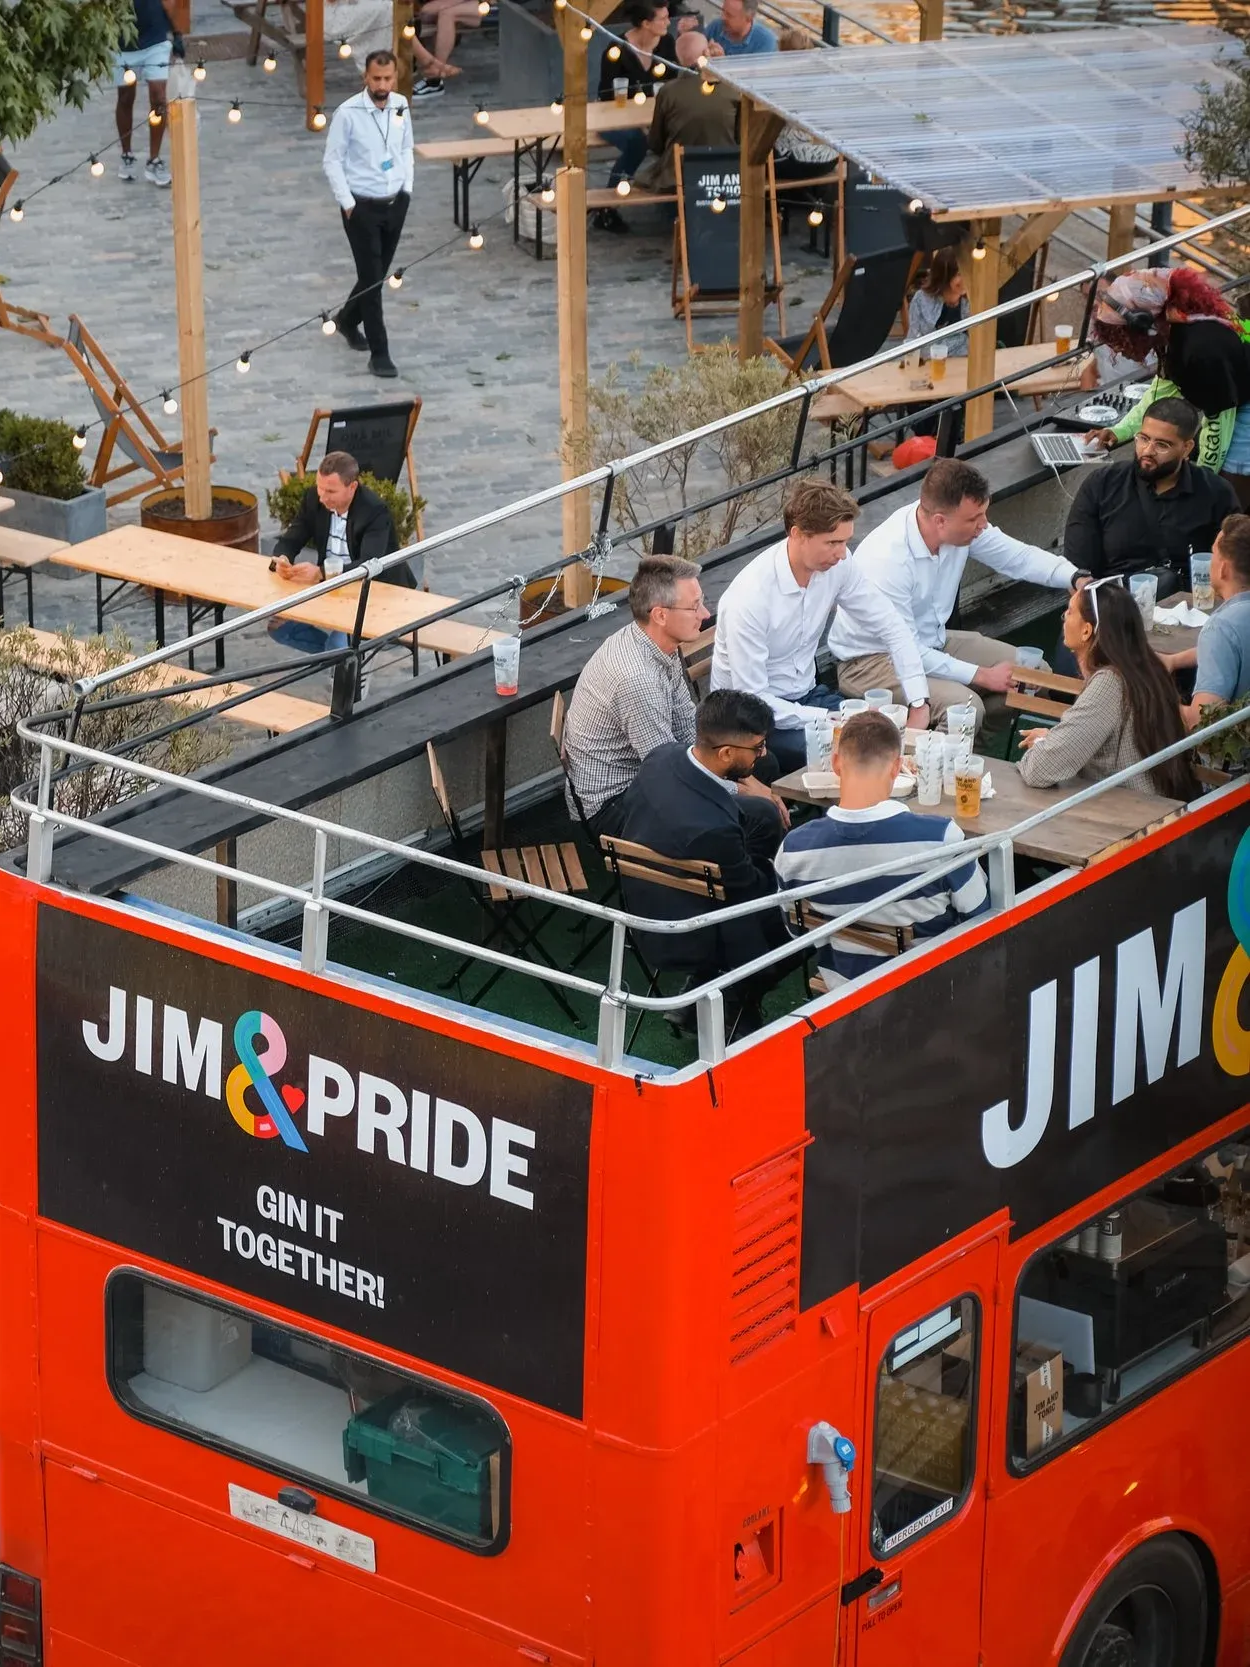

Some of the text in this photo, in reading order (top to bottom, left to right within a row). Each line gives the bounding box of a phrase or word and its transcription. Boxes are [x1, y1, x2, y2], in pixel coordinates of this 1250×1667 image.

[698, 173, 741, 186] JIM AN
[981, 897, 1206, 1169] JIM
[256, 1185, 344, 1243] GIN IT
[217, 1216, 385, 1309] TOGETHER!
[1034, 1391, 1059, 1414] JIM AND
[1037, 1403, 1056, 1421] TONIC
[886, 1500, 953, 1549] EMERGENCY EXIT
[861, 1618, 876, 1633] PULL
[886, 1599, 903, 1617] OPEN
